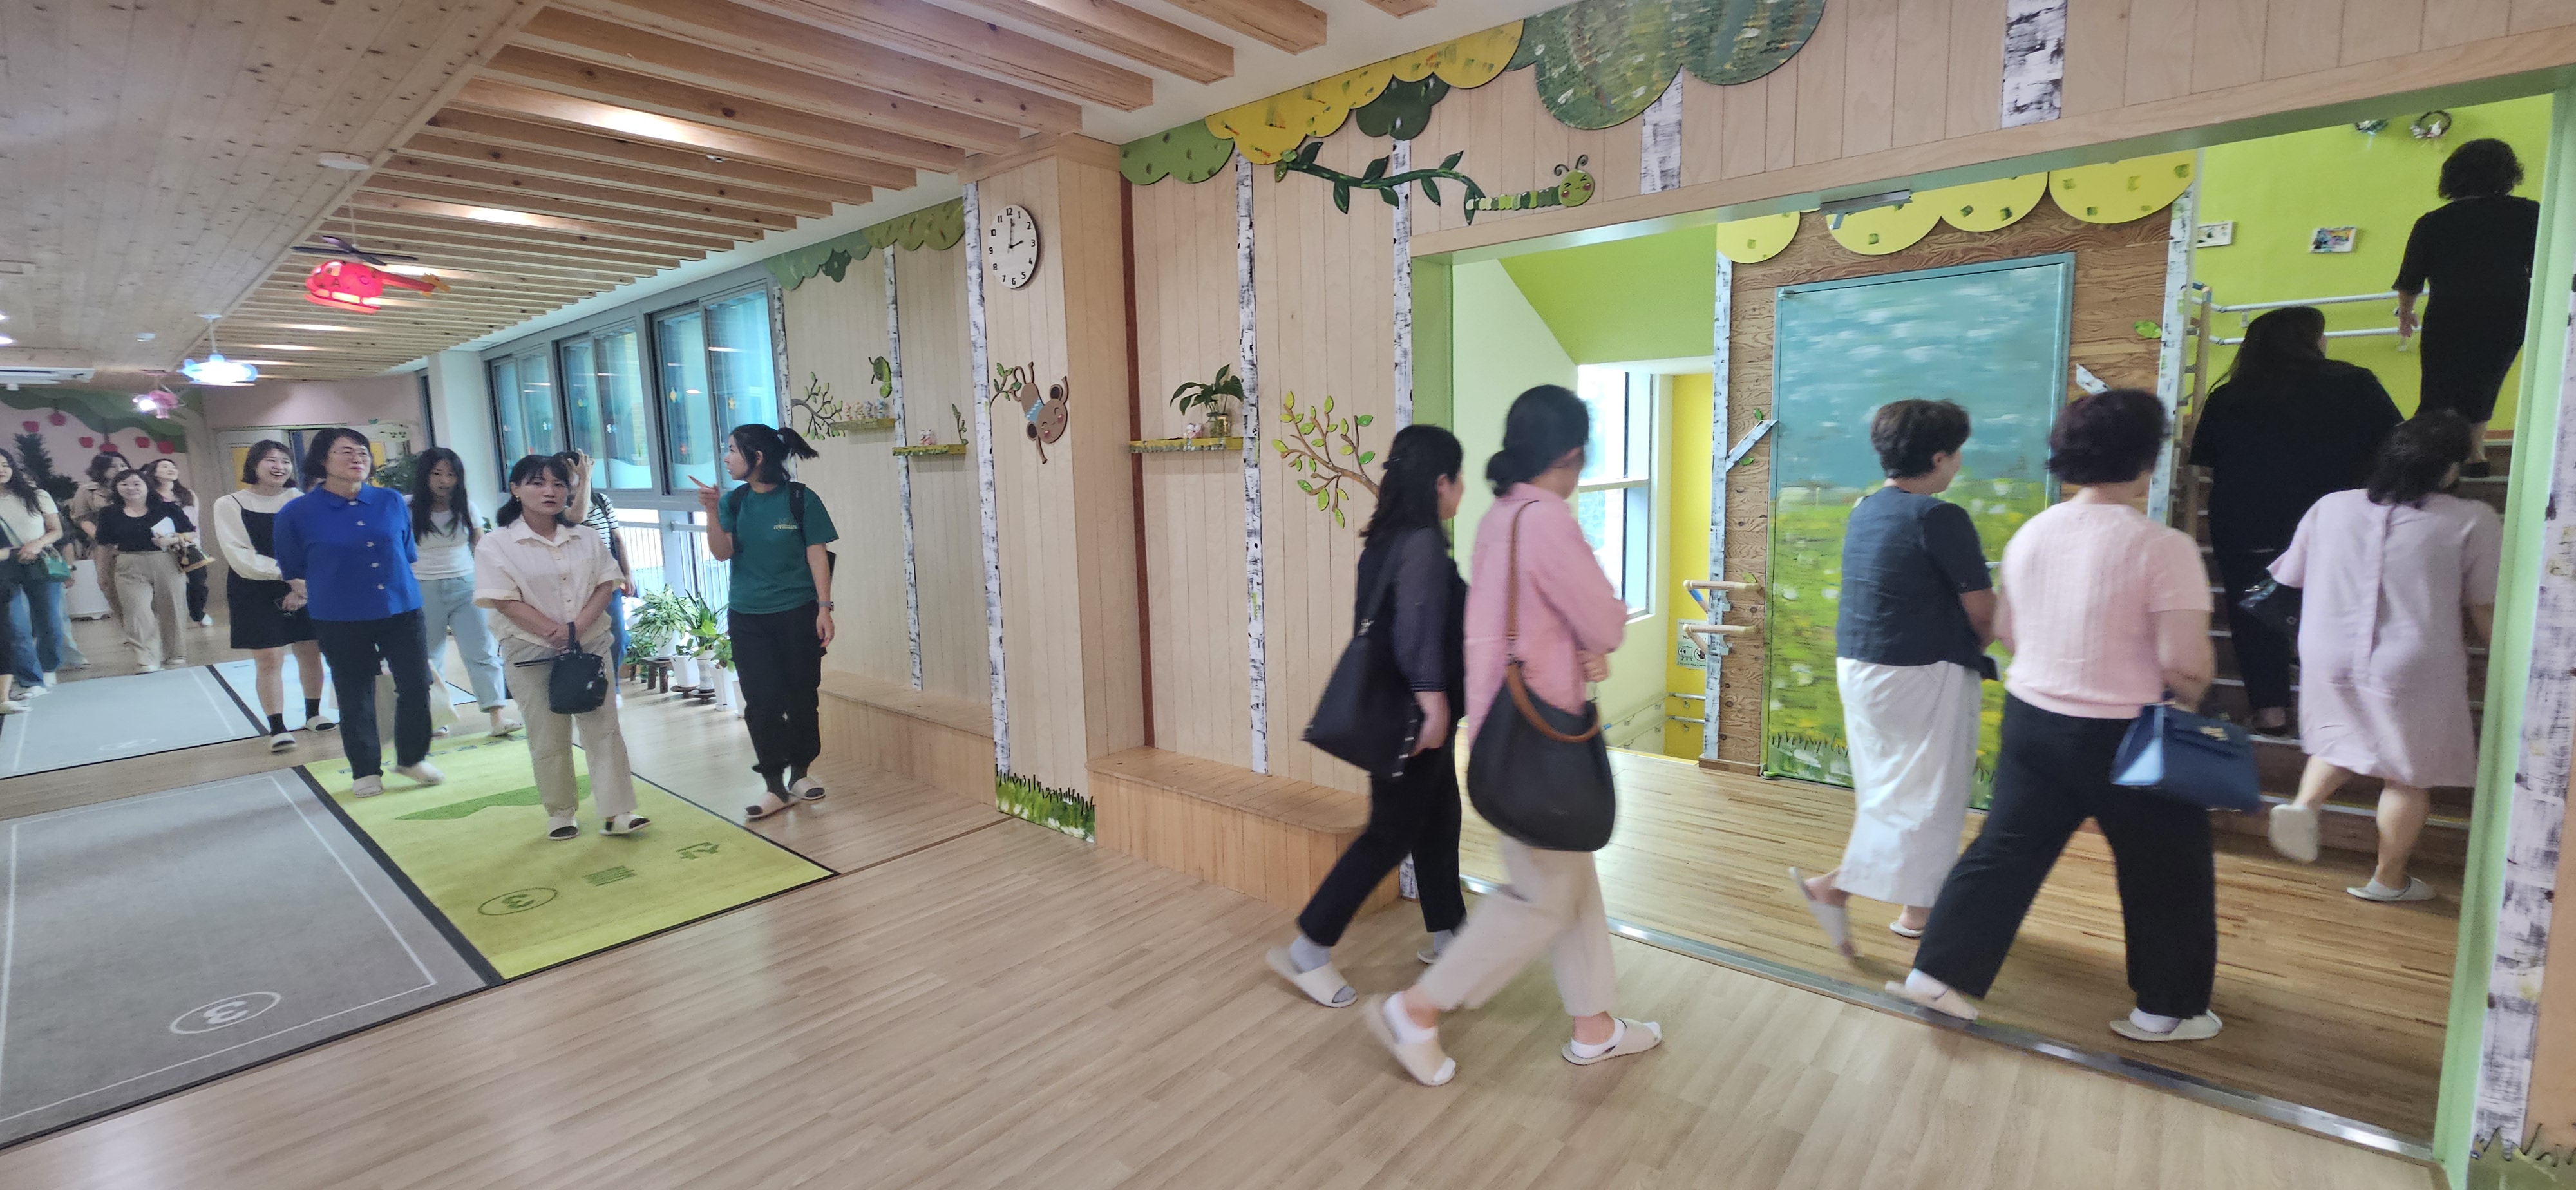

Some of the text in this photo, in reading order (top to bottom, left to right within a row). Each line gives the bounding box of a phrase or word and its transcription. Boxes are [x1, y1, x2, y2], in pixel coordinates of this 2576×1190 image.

[1006, 207, 1013, 216] 12
[1018, 211, 1021, 219] 1
[1027, 222, 1032, 230] 2
[1030, 239, 1036, 247] 3
[992, 263, 998, 271] 8
[1001, 274, 1006, 283] 7
[1021, 271, 1026, 279] 5
[1011, 277, 1016, 285] 6
[203, 1001, 249, 1025] 3
